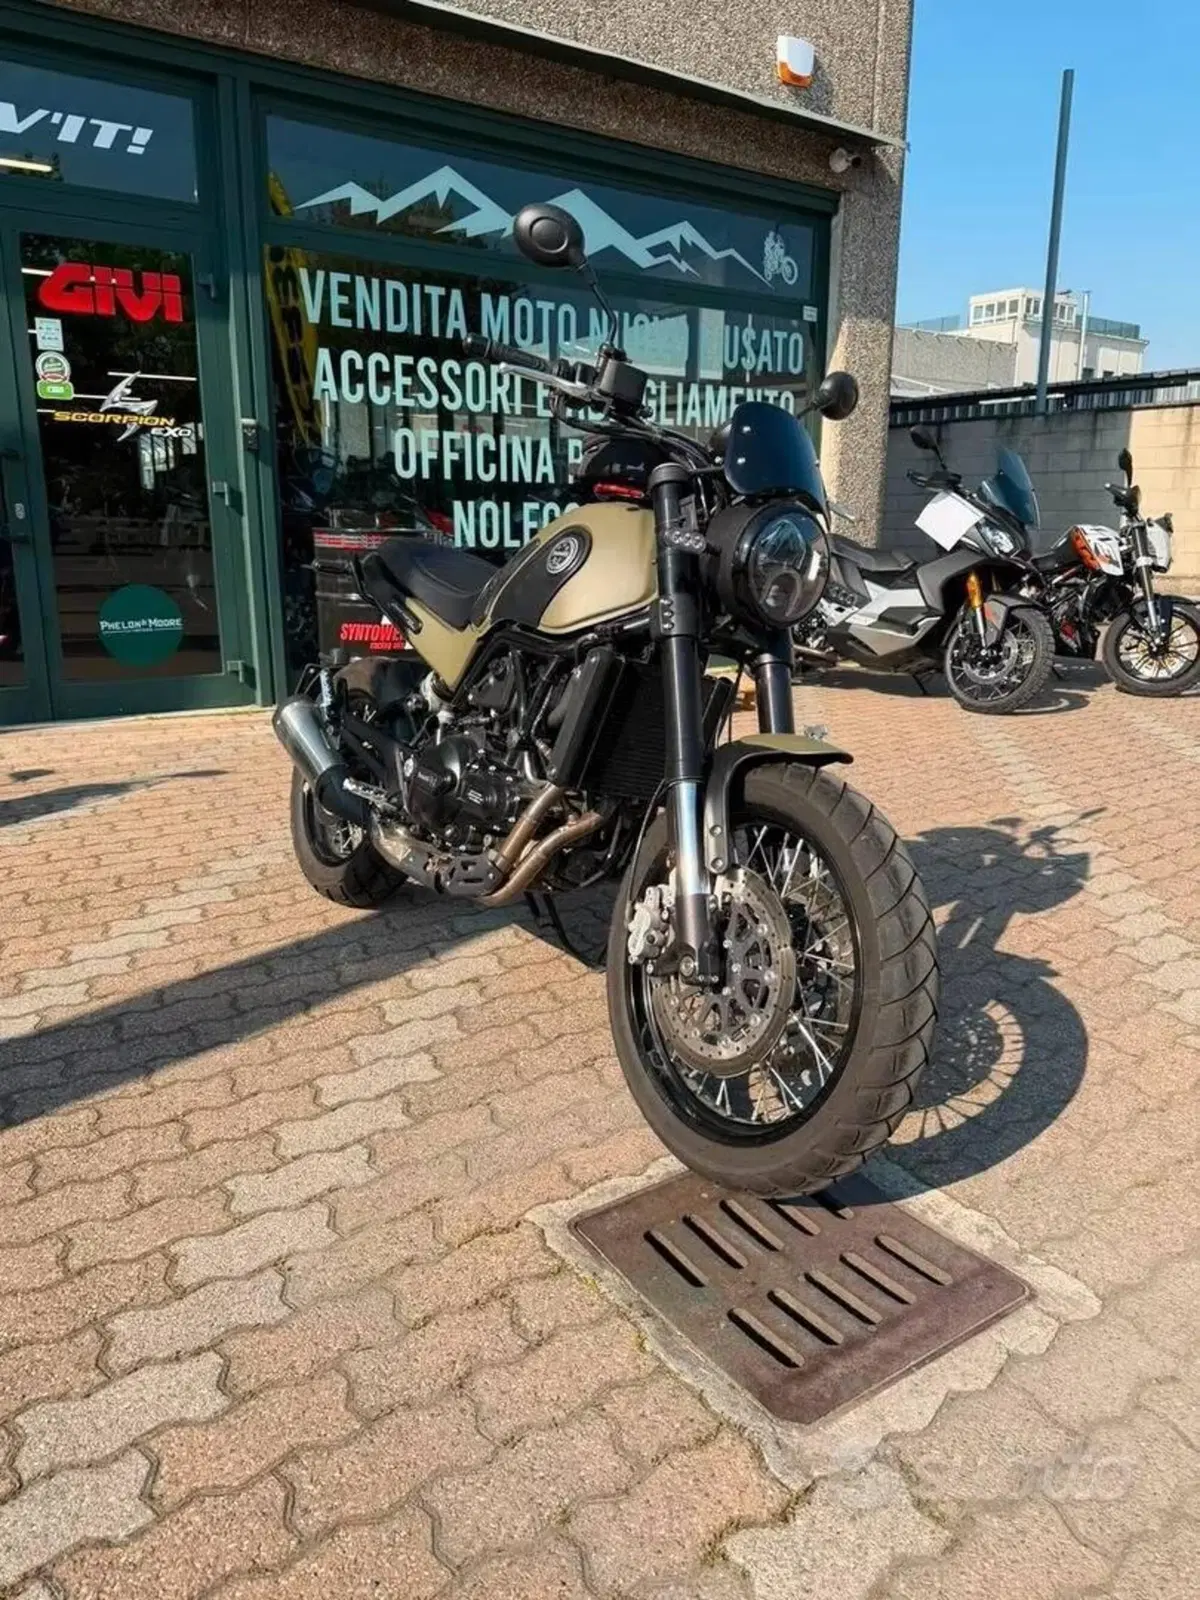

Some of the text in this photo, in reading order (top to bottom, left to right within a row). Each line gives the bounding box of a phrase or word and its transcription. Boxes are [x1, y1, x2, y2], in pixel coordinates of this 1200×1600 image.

[38, 262, 183, 322] GIVI
[299, 267, 467, 340] VENDITA
[481, 292, 577, 352] MOTO
[723, 324, 804, 375] USATO
[313, 347, 522, 415] ACCESSORI
[53, 411, 175, 427] SCORPION
[394, 427, 555, 484] OFFICINA
